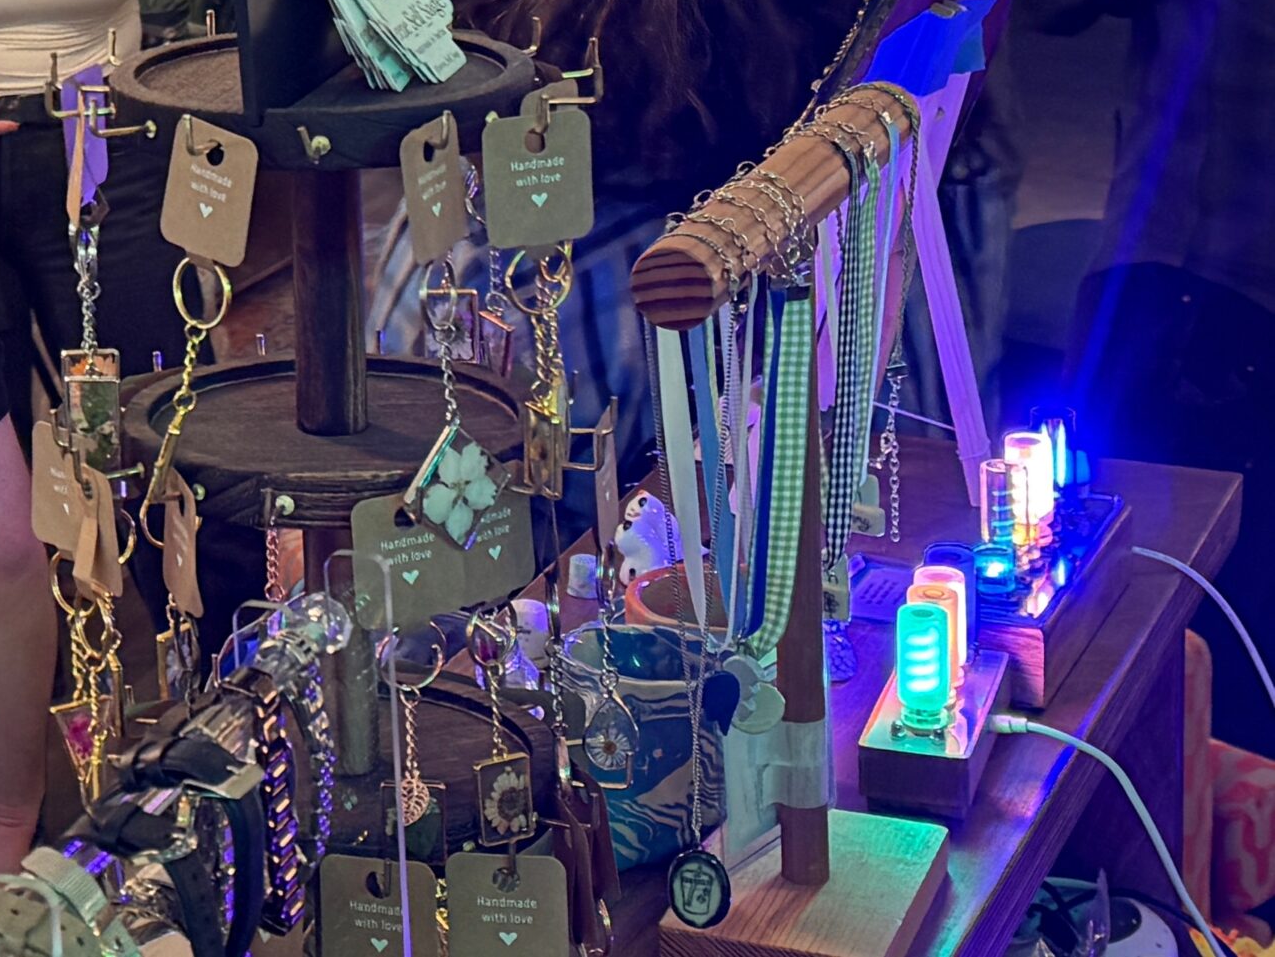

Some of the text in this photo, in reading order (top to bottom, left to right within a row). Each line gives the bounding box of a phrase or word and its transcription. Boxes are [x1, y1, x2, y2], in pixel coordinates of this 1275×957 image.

[510, 156, 565, 172] Handmade
[515, 173, 562, 188] with love
[380, 532, 436, 552] Handmade
[386, 549, 432, 566] with love
[349, 900, 403, 917] Handmad
[477, 895, 538, 910] Handmade
[354, 919, 378, 930] with
[481, 913, 534, 925] with love
